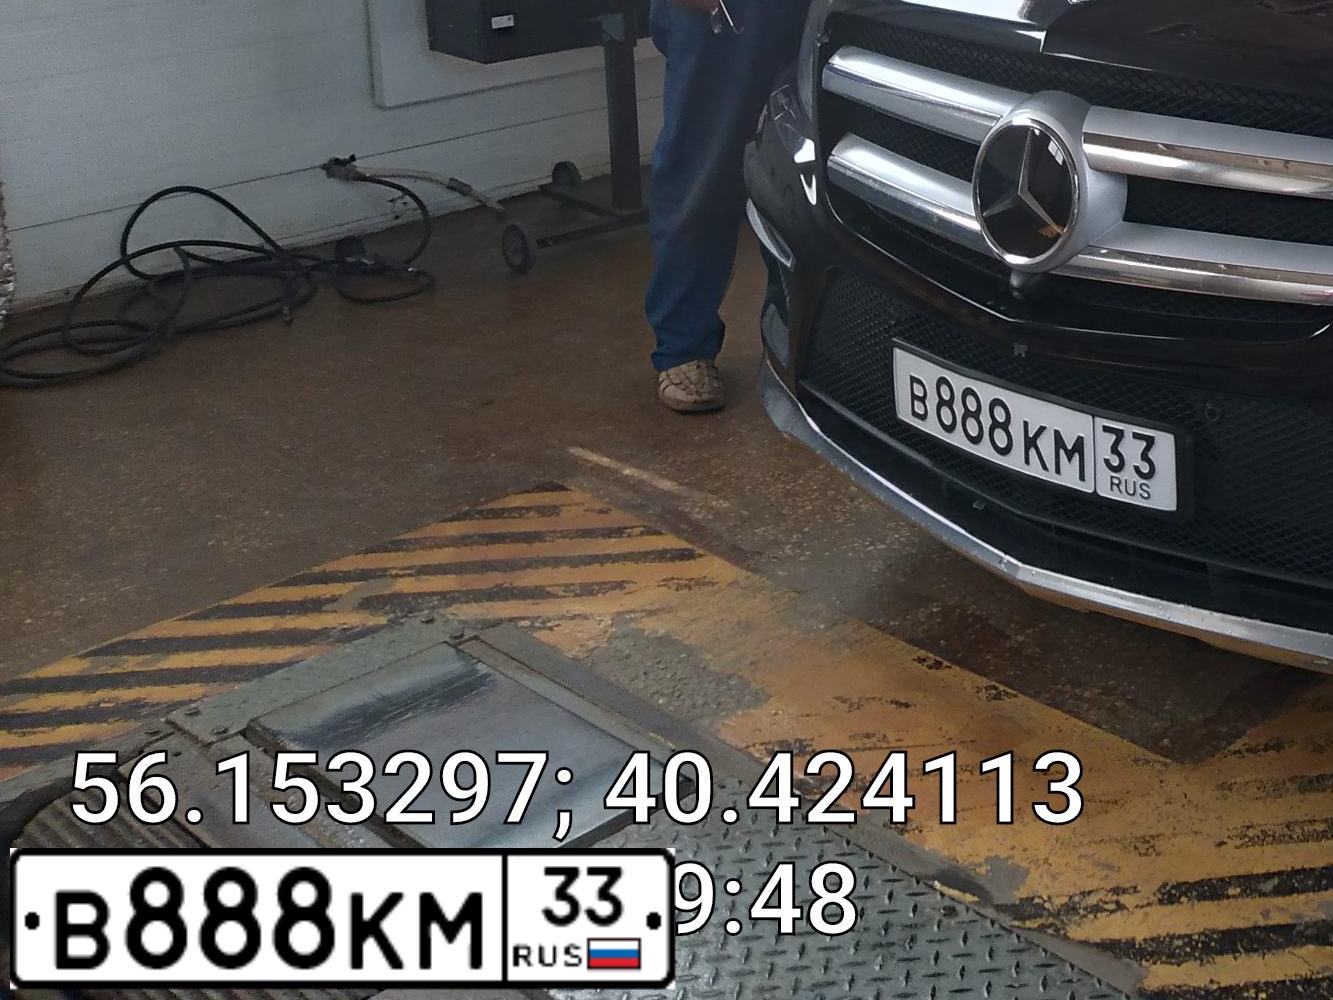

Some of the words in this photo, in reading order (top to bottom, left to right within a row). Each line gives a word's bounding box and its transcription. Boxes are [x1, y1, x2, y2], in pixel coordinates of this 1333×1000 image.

[908, 374, 1087, 482] В888КМ
[1102, 424, 1156, 480] 33
[1109, 475, 1151, 499] RUS
